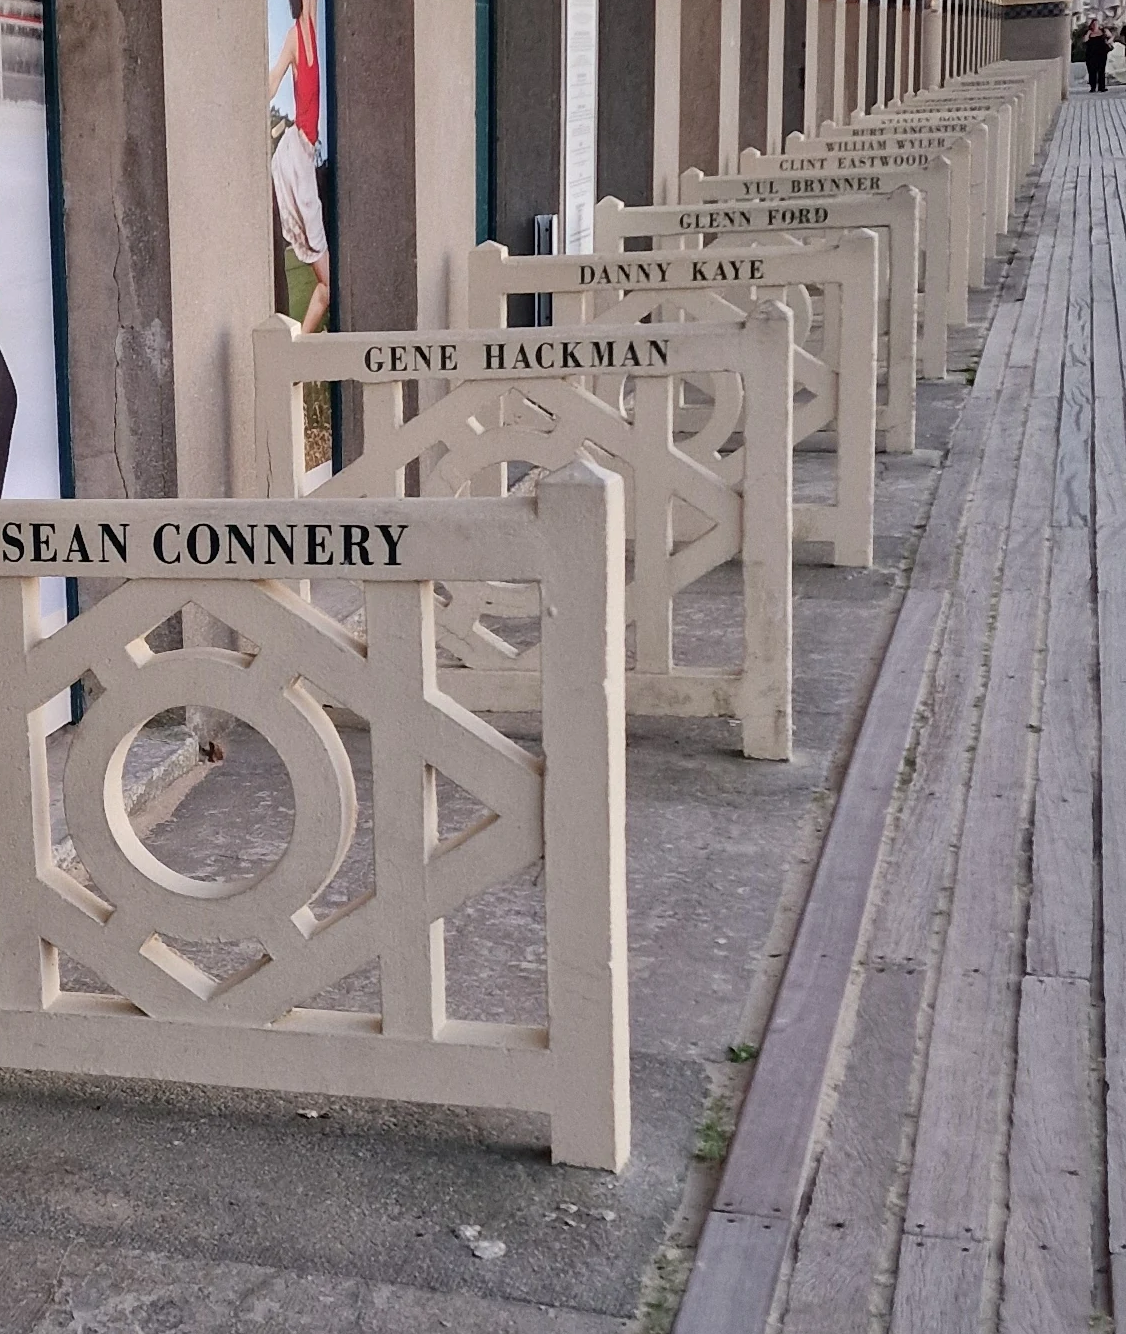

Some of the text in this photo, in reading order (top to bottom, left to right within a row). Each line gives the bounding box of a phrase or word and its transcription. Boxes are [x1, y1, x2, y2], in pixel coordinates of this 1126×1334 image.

[826, 138, 946, 152] WILLIAM WYLER
[779, 154, 929, 171] CLINT EASTWOOD
[743, 176, 881, 195] YUL BRYNNER
[679, 207, 829, 229] GLENN FORD
[579, 259, 766, 285] DANNY KAYE
[364, 339, 671, 373] GENE HACKMAN
[1, 521, 410, 566] SEAN CONNERY
